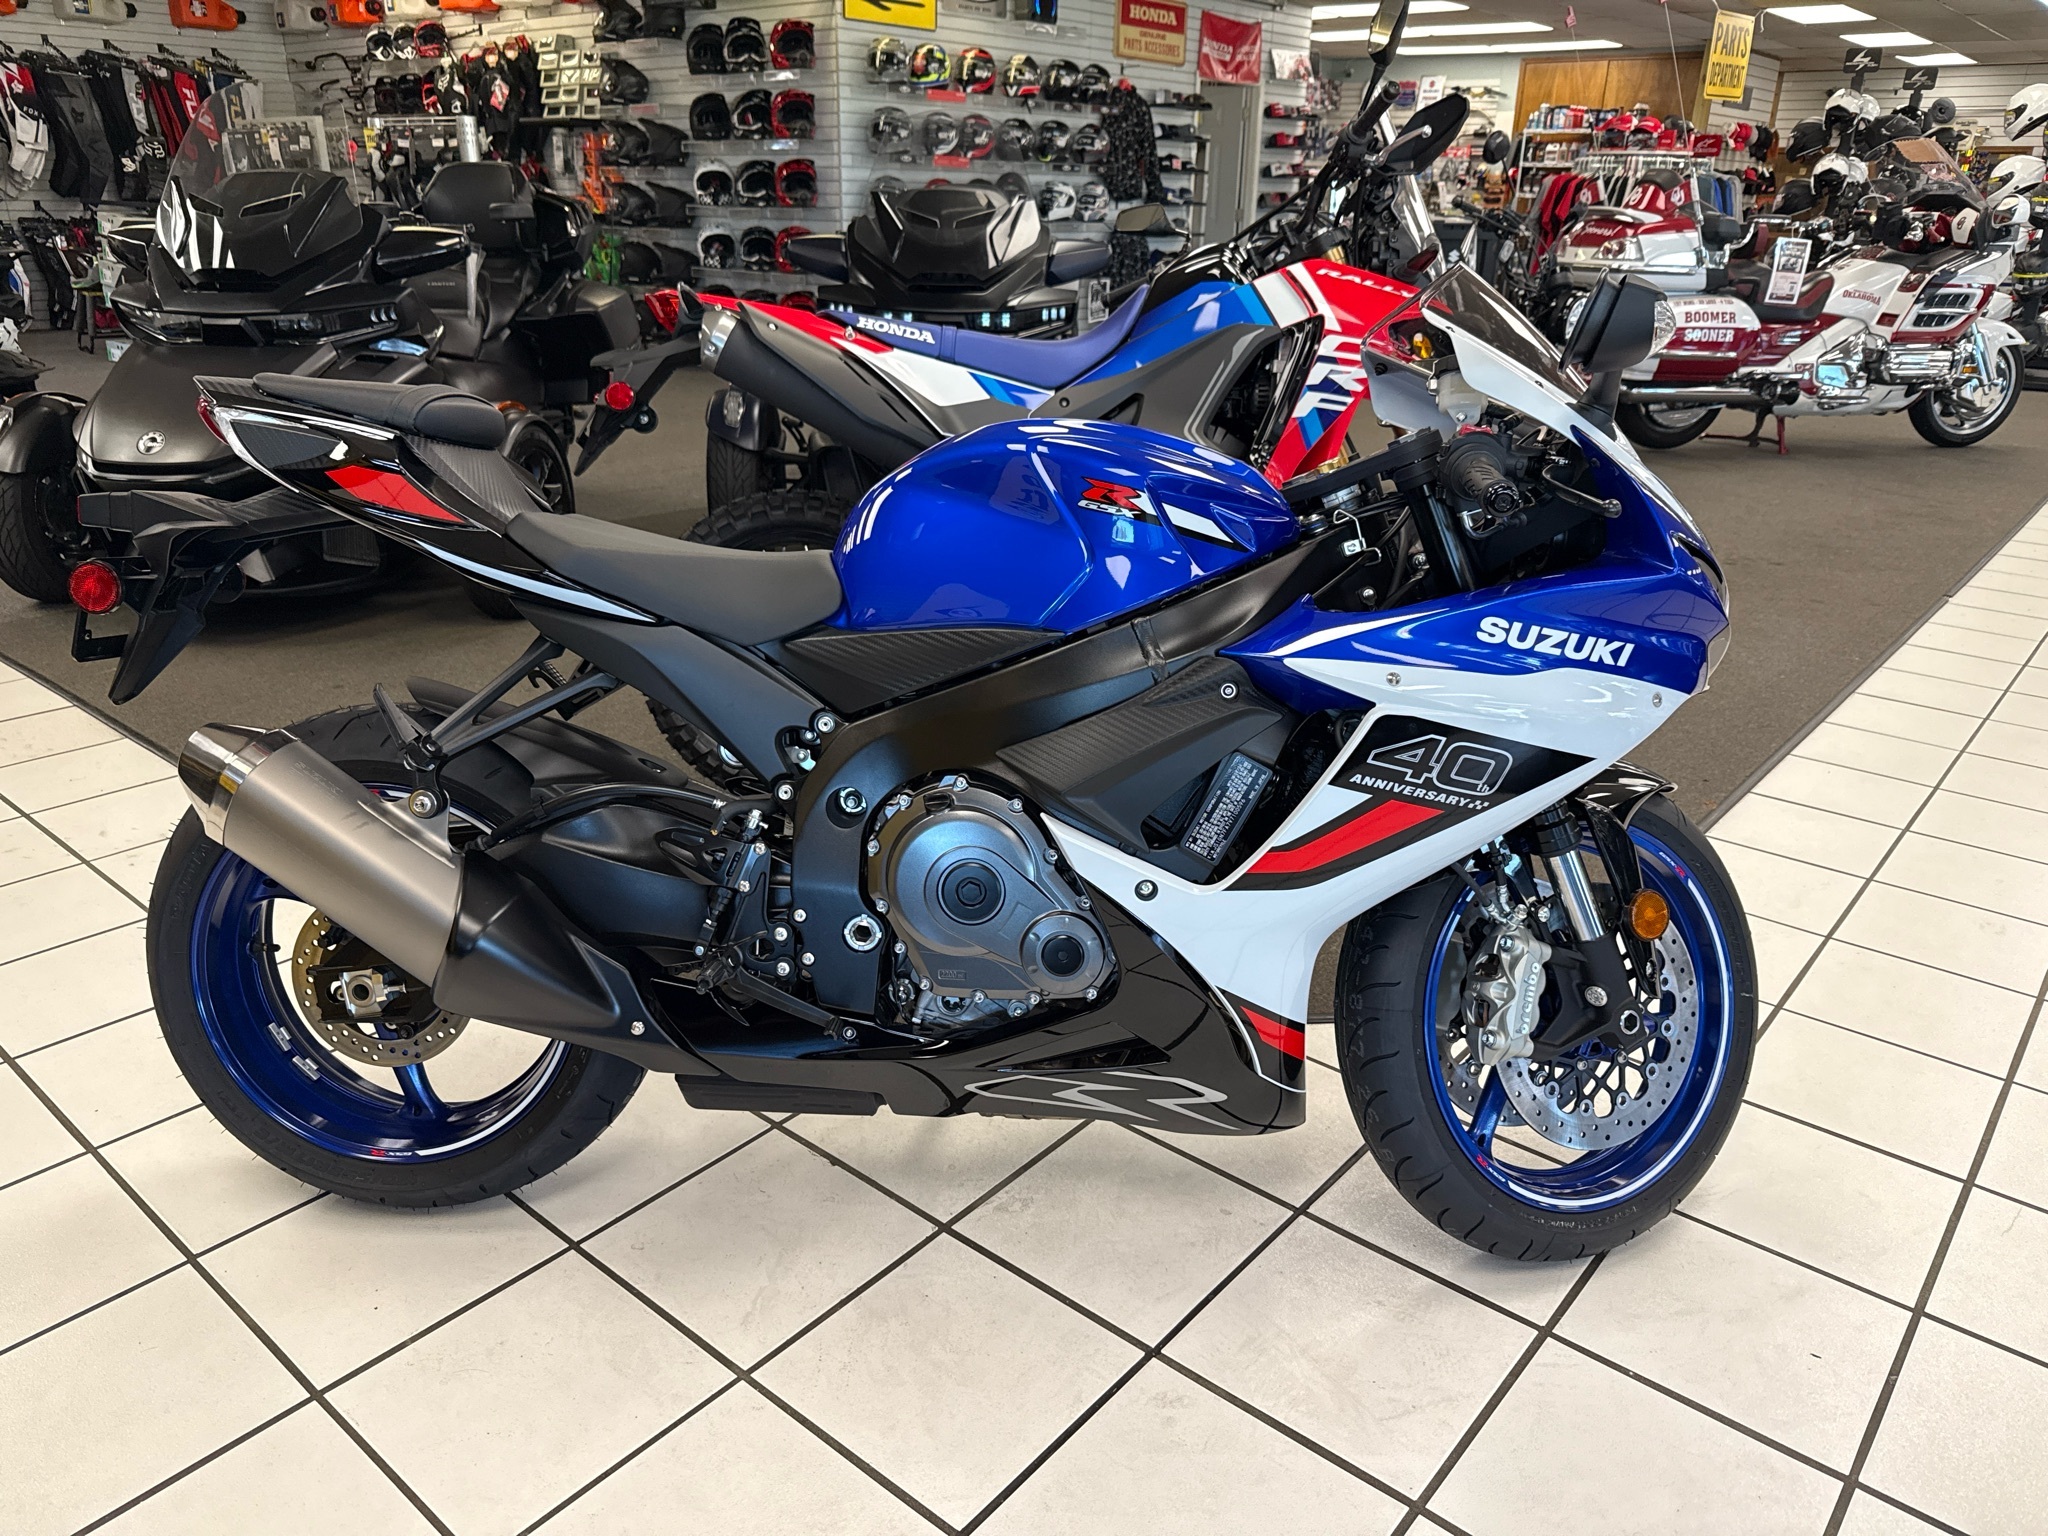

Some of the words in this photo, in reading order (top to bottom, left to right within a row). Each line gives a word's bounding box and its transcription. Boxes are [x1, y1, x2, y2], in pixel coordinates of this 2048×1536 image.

[1129, 4, 1178, 26] HONDA
[1139, 30, 1166, 40] GENUINE
[1714, 22, 1750, 58] PARTS
[1124, 37, 1142, 52] PARTS
[1144, 40, 1180, 58] ACCESSORIES
[1708, 62, 1746, 88] DEPARTMENT
[1316, 268, 1416, 298] RALLY
[1842, 290, 1882, 306] OKLAHOMA
[856, 316, 936, 344] HONDA
[1685, 312, 1736, 324] BOOMER
[1684, 329, 1734, 342] SOONER
[1078, 499, 1142, 518] GSX
[1476, 616, 1636, 668] SUZUKI
[1350, 774, 1469, 808] ANNIVERSARY
[1515, 961, 1540, 1035] brembo
